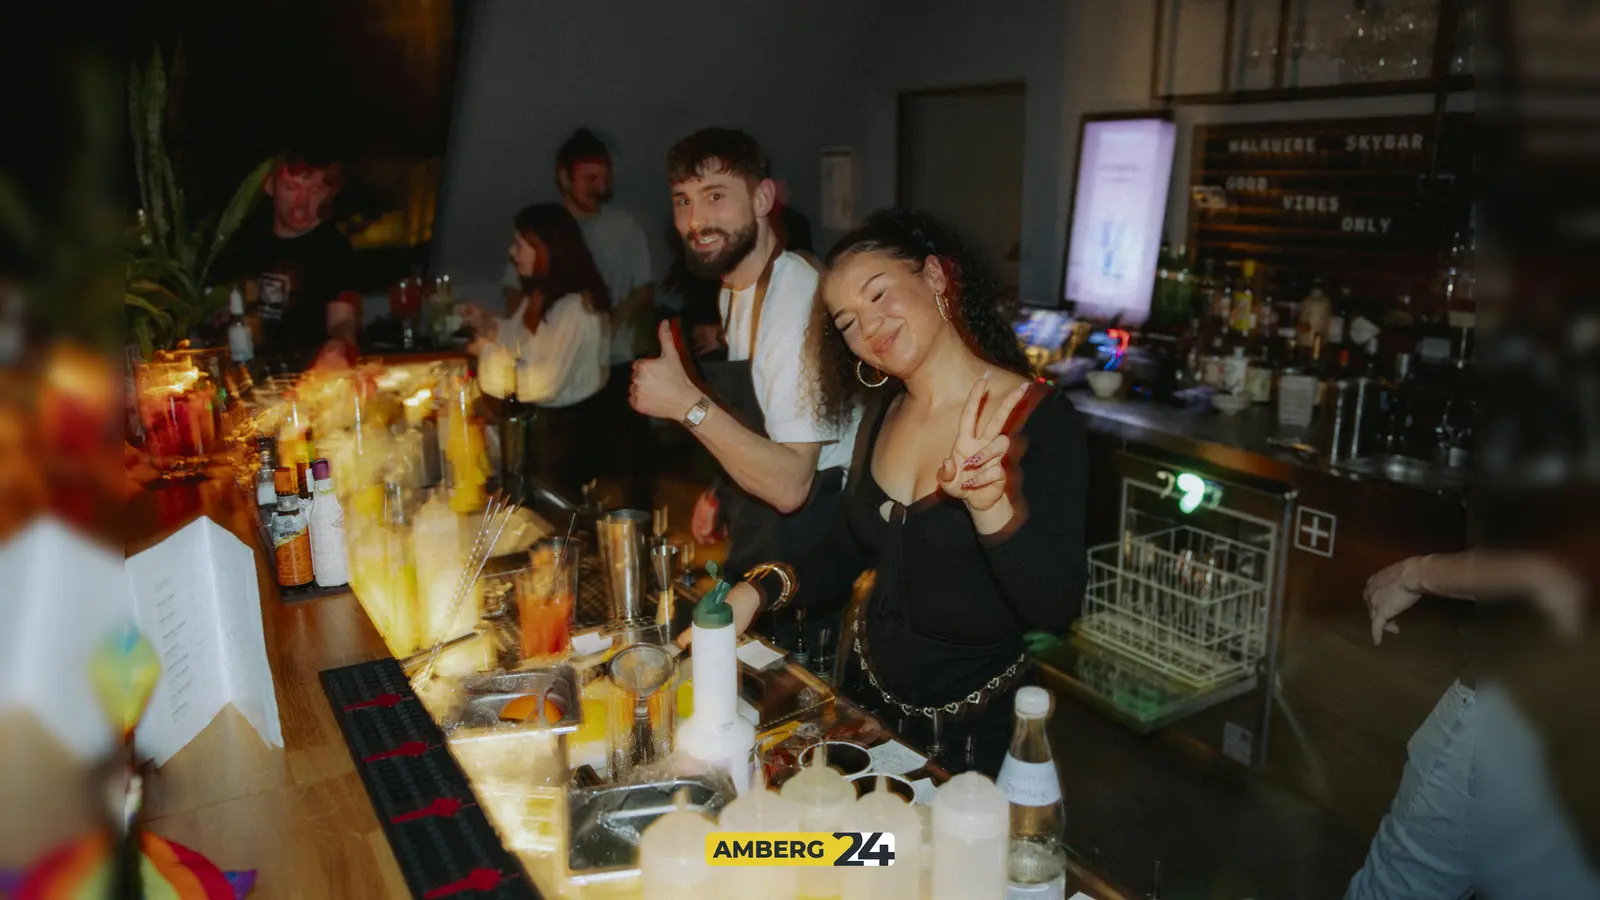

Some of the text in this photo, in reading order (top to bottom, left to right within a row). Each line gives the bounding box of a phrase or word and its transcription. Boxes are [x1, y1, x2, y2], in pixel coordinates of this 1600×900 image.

[1345, 133, 1424, 152] SKYBAR
[1225, 176, 1268, 191] GOOD
[1282, 194, 1340, 212] VIBES
[1341, 216, 1392, 233] ONLY
